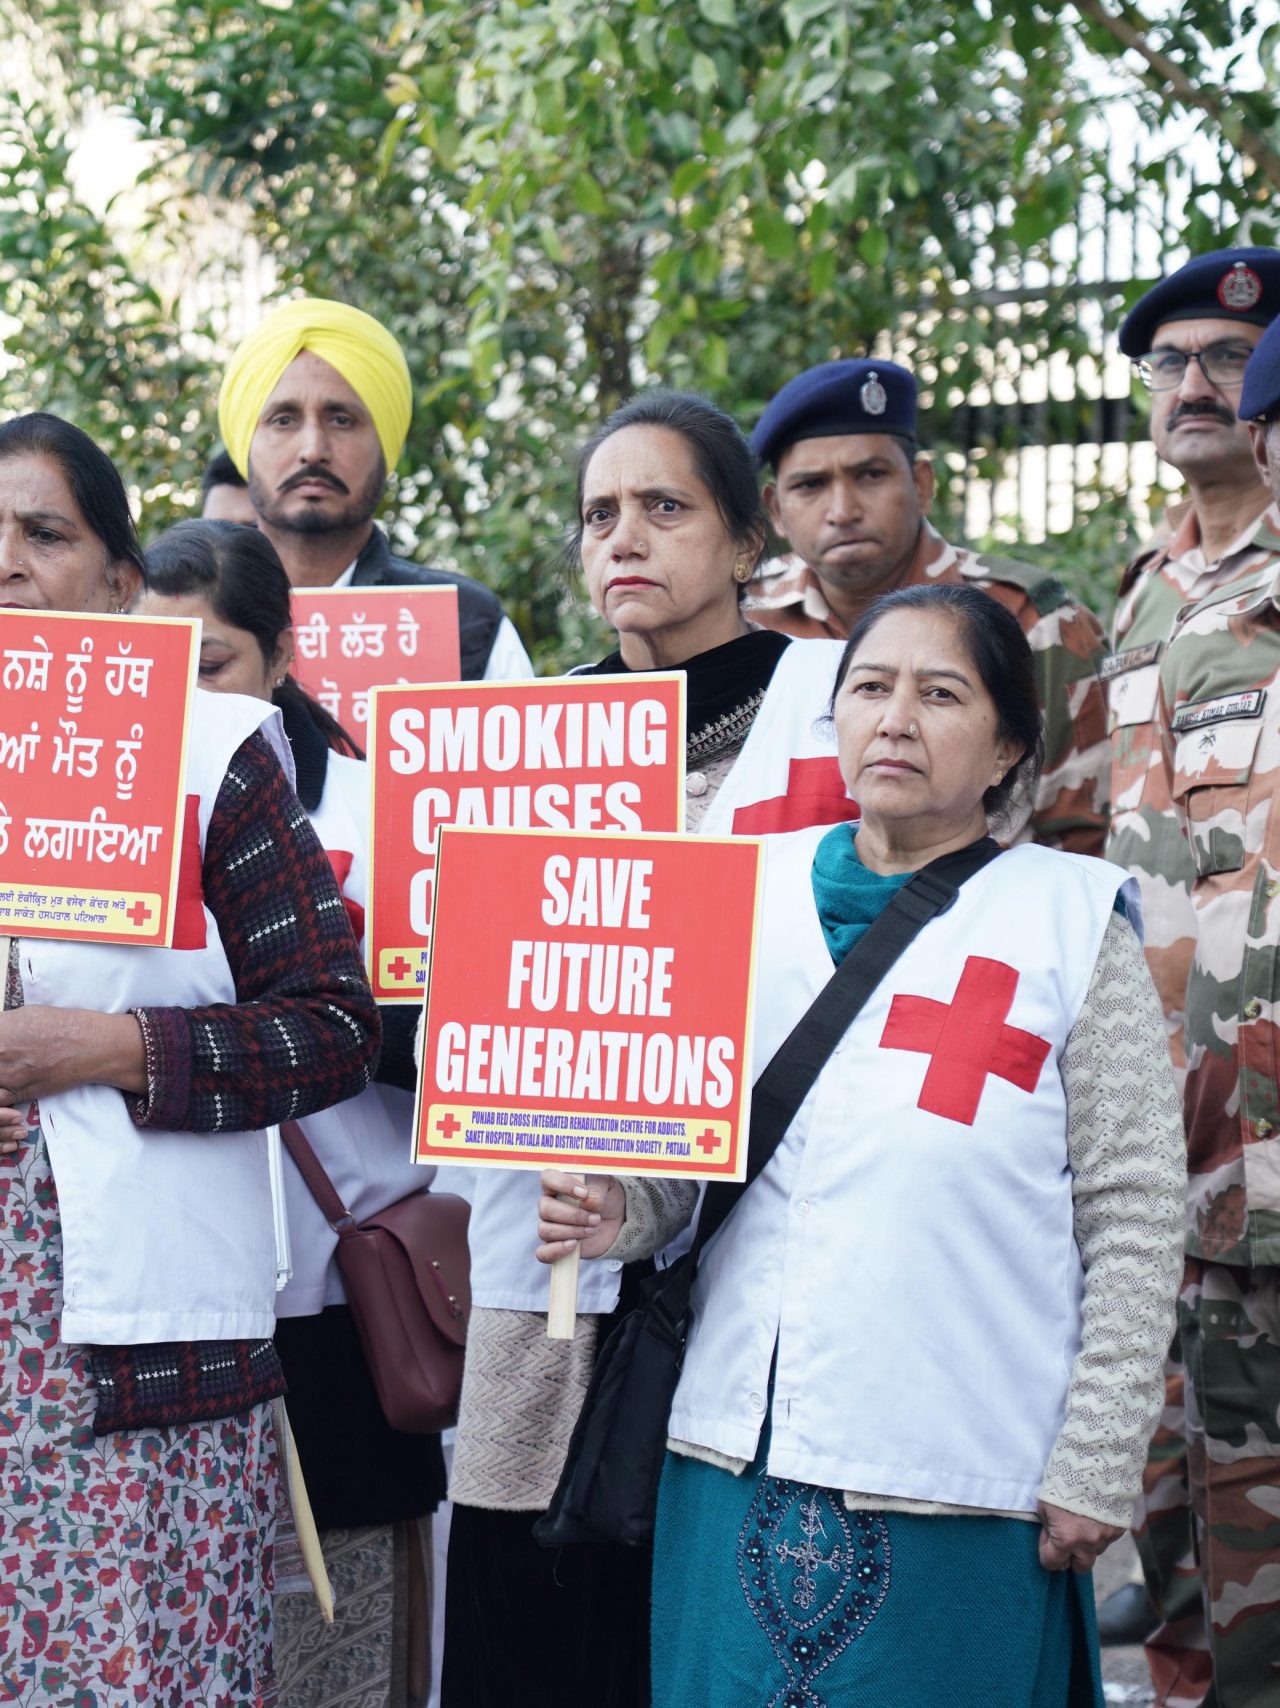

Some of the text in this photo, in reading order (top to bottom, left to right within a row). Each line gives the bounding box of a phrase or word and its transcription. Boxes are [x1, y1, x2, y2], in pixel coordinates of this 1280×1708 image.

[297, 608, 420, 659] ਦੀ ਲੱਤ ਹੈ
[3, 635, 53, 692] ਨਸ਼ੇ
[65, 636, 94, 713] ਨੂੰ
[105, 641, 154, 698] ਹੱਥ
[52, 716, 104, 778] ਮੌਤ
[115, 723, 144, 800] ਨੂੰ
[389, 699, 667, 775] SMOKING
[23, 806, 163, 866] ਲਗਾਇਆ
[541, 854, 653, 929] SAVE
[507, 940, 675, 1017] FUTURE
[435, 1021, 736, 1109] GENERATIONS
[465, 1129, 485, 1144] SAKET
[485, 1131, 514, 1146] HOSPITAL
[515, 1132, 540, 1147] PATIALA
[540, 1133, 554, 1148] AND
[555, 1134, 585, 1150] DISTRICT
[585, 1136, 634, 1152] REHABILITATION
[665, 1142, 691, 1156] PATIALA
[472, 1110, 496, 1126] PUNJAB
[496, 1112, 509, 1126] RED
[509, 1113, 531, 1128] CROSS
[531, 1114, 569, 1129] INTEGRATED
[569, 1116, 619, 1133] REHABILITATION
[620, 1119, 643, 1133] CENTRE
[644, 1120, 657, 1134] FOR
